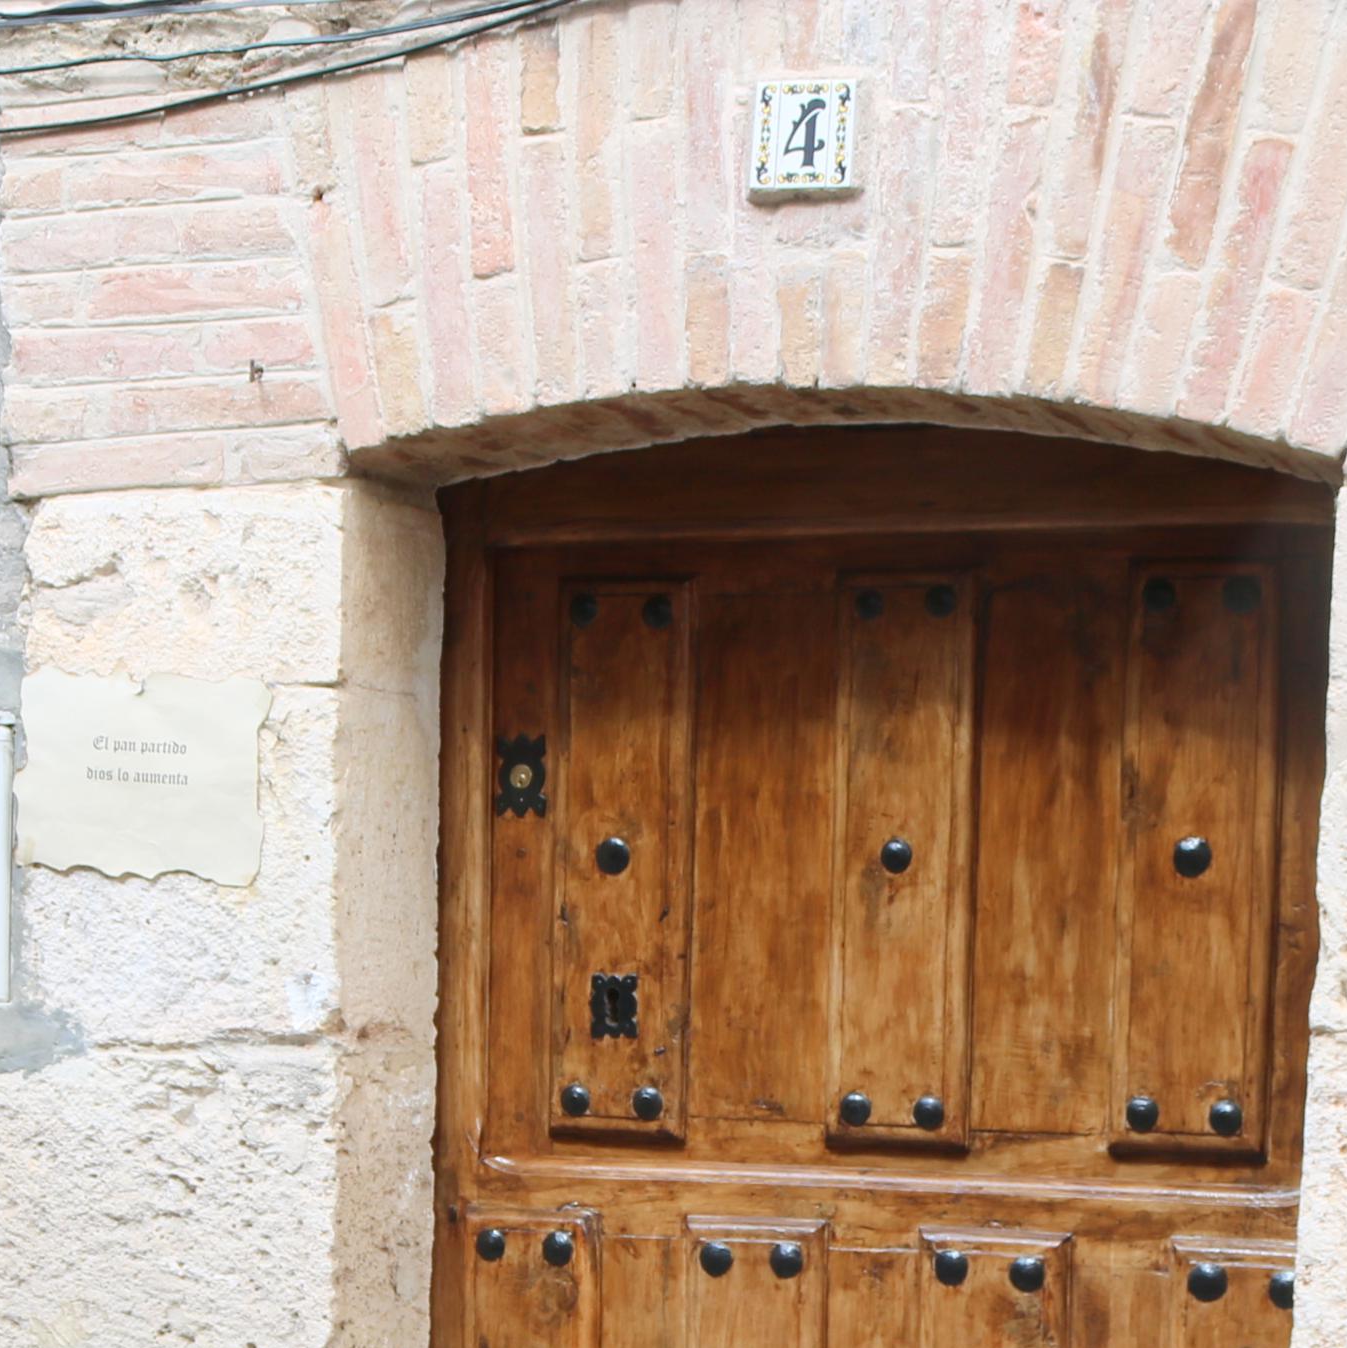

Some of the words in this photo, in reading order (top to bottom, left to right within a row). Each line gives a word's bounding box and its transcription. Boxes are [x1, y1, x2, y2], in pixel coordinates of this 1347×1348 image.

[783, 98, 827, 169] 4
[93, 735, 109, 751] El
[113, 739, 136, 753] pan
[140, 741, 188, 755] partido
[117, 768, 130, 782] lo
[133, 771, 189, 786] aumenta
